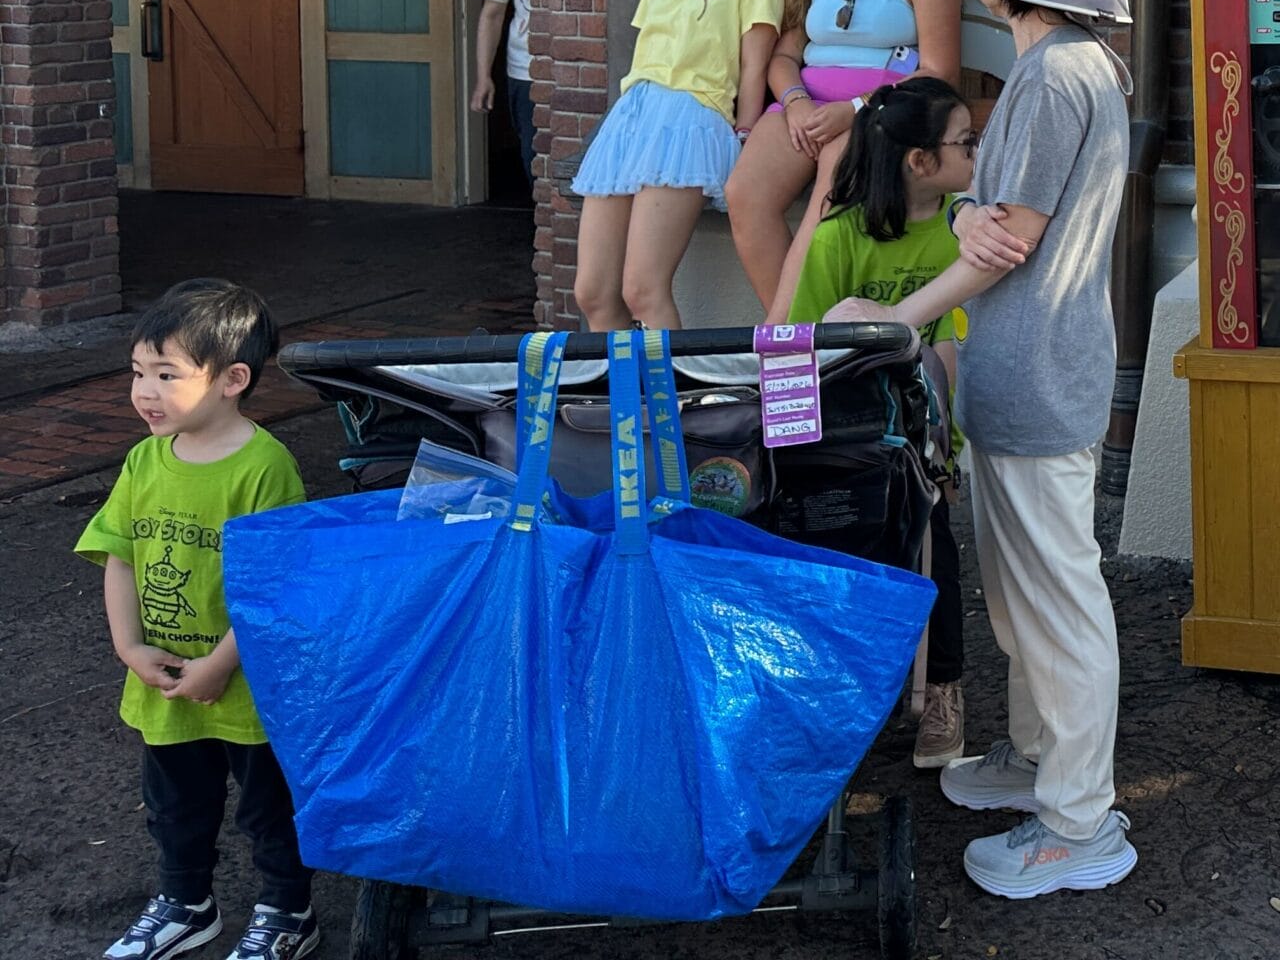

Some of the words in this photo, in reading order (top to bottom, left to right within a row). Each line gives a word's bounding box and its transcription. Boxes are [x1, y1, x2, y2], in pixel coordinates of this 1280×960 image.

[769, 422, 811, 437] DANG
[616, 414, 642, 519] IKEA
[178, 511, 199, 520] PIXAR
[168, 632, 220, 644] CHOSEN!
